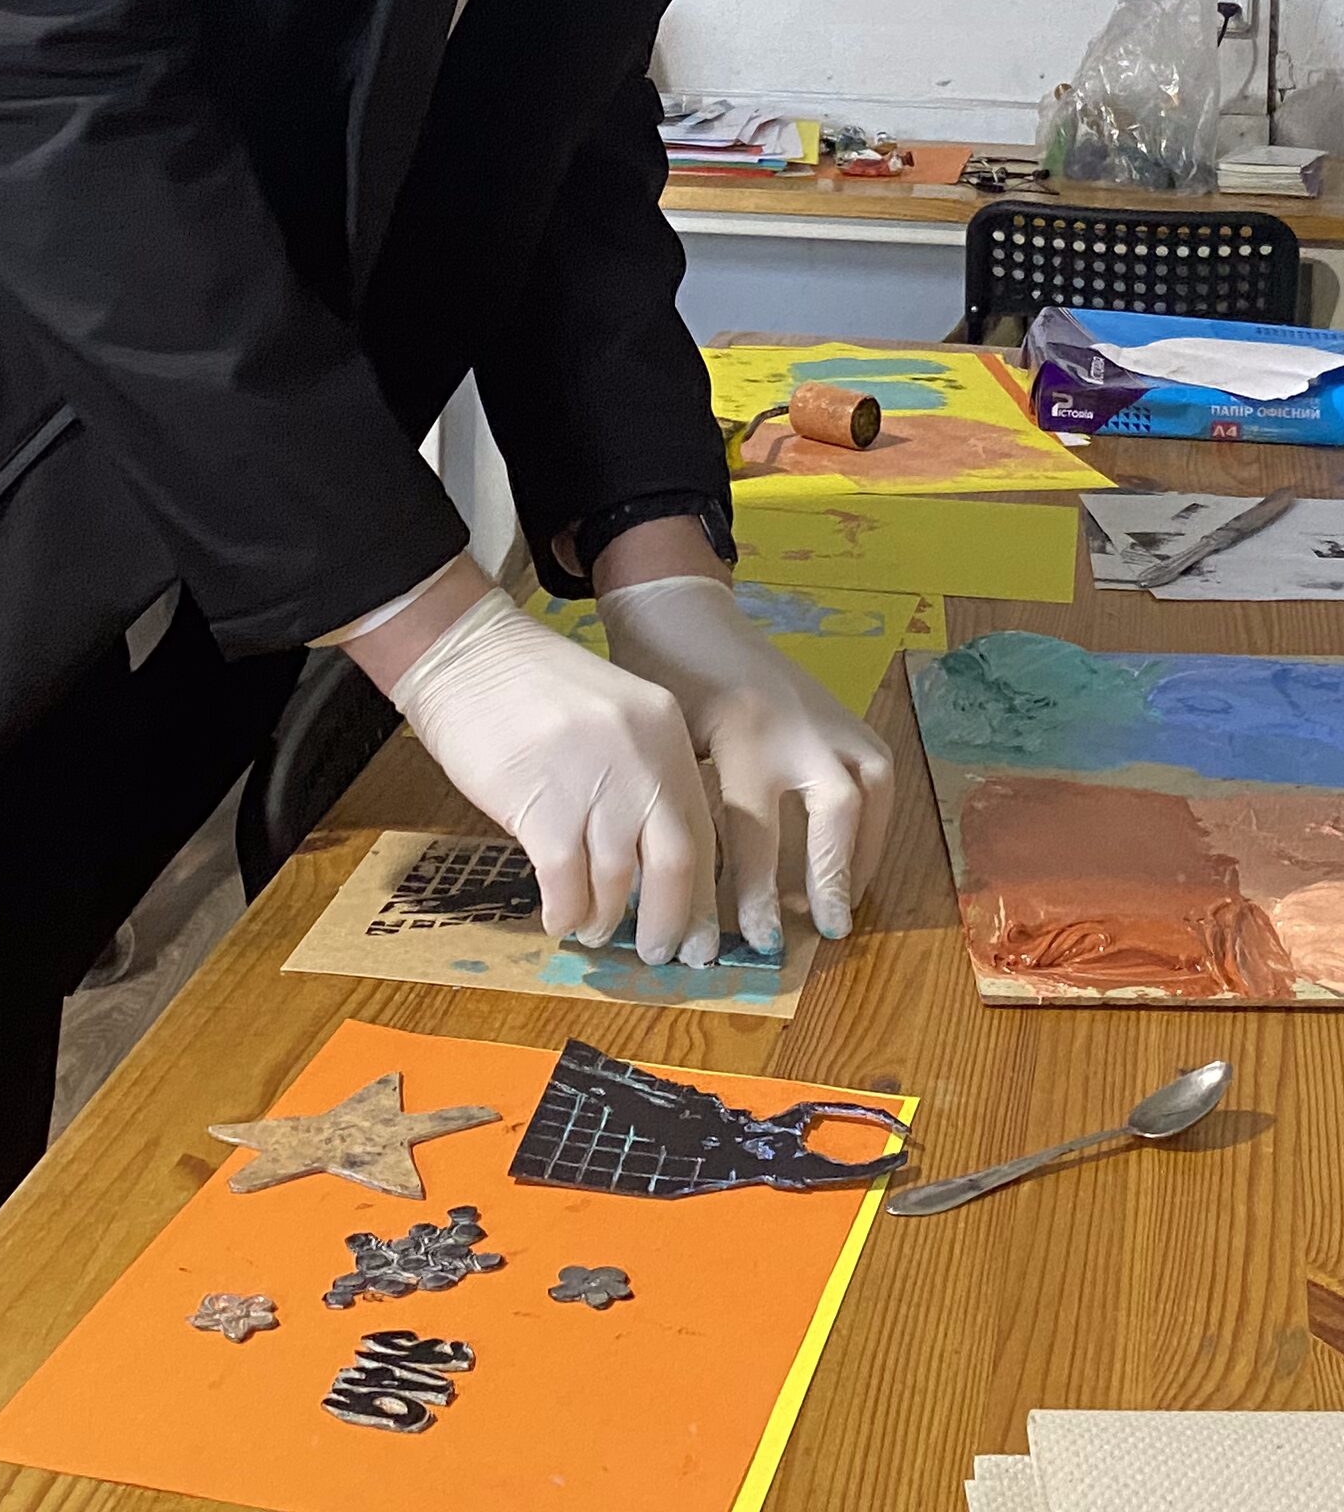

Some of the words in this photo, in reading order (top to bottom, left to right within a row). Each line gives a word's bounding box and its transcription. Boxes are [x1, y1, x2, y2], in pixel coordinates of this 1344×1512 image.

[1211, 405, 1254, 418] ПАПІР
[1257, 407, 1321, 419] ОФІСНИЙ
[1212, 425, 1238, 438] A4
